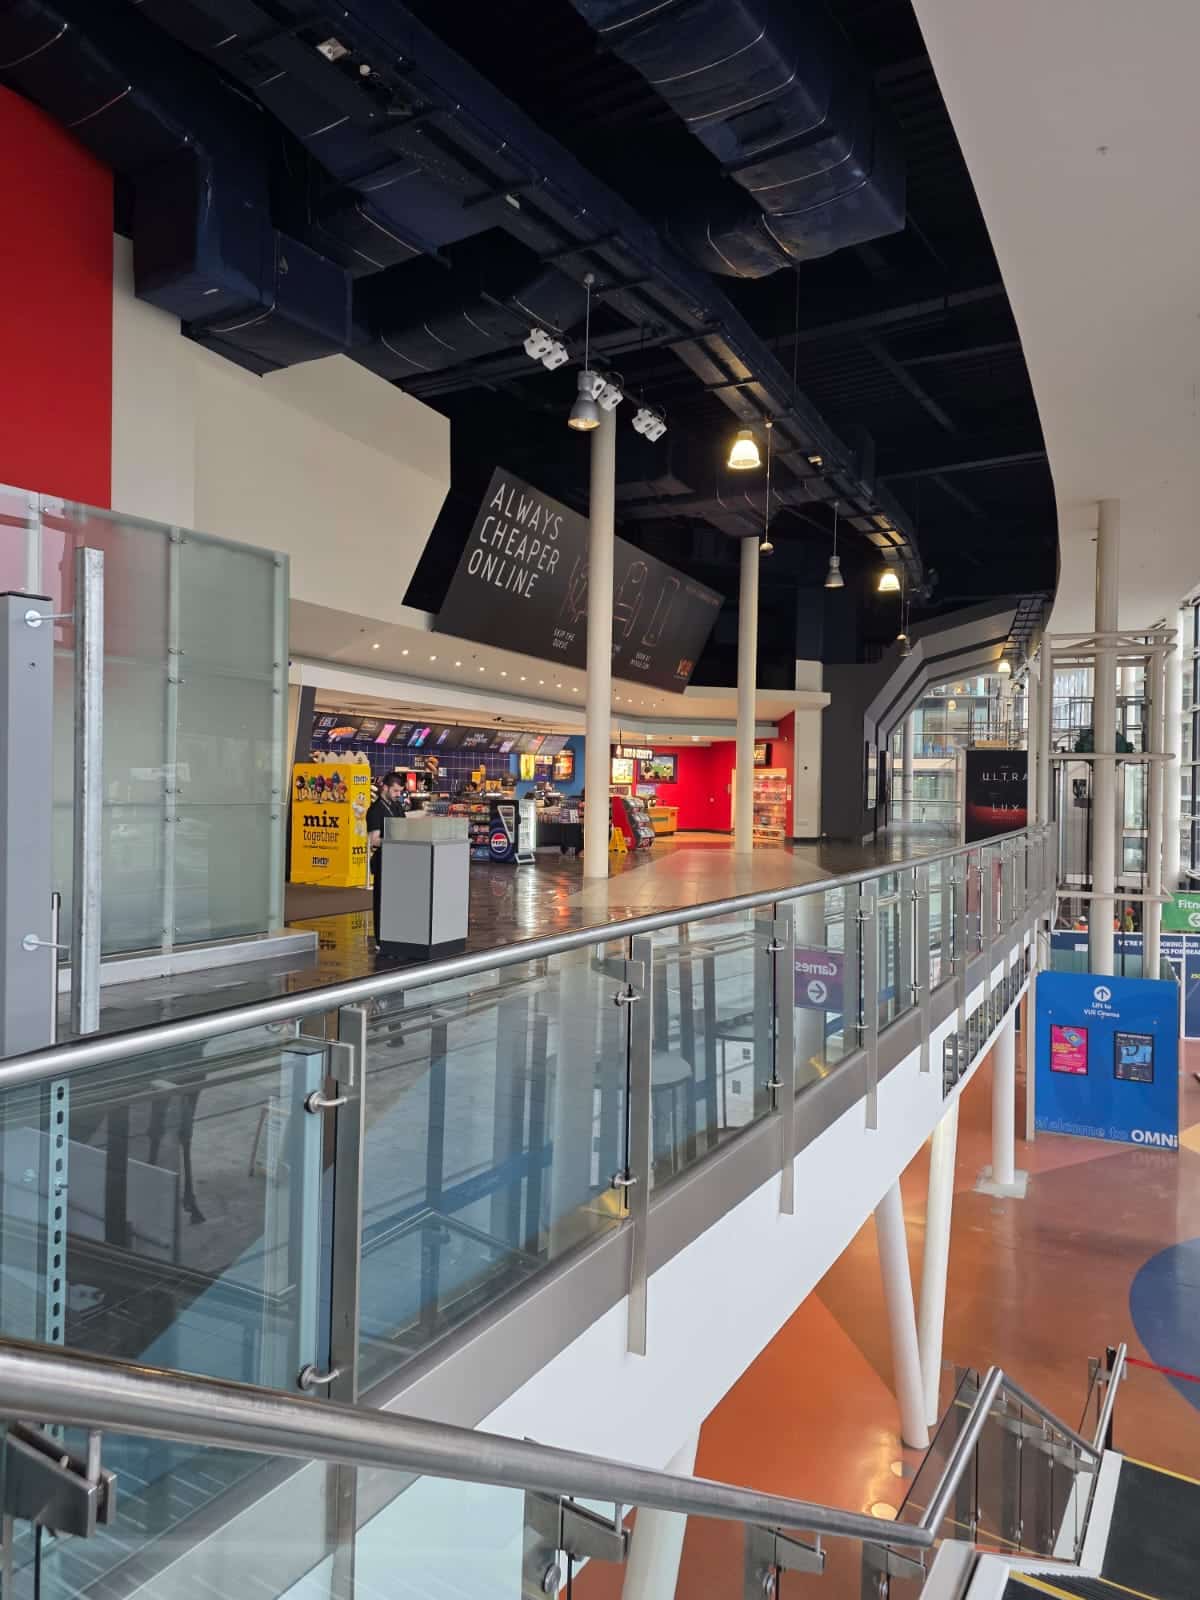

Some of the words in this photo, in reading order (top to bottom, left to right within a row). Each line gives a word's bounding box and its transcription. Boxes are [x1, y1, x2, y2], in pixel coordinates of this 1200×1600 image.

[490, 483, 564, 541] ALWAYS
[480, 515, 561, 575] CHEAPER
[467, 548, 540, 599] ONLINE
[303, 810, 340, 829] mix
[992, 802, 1020, 813] LUX
[303, 829, 340, 845] together
